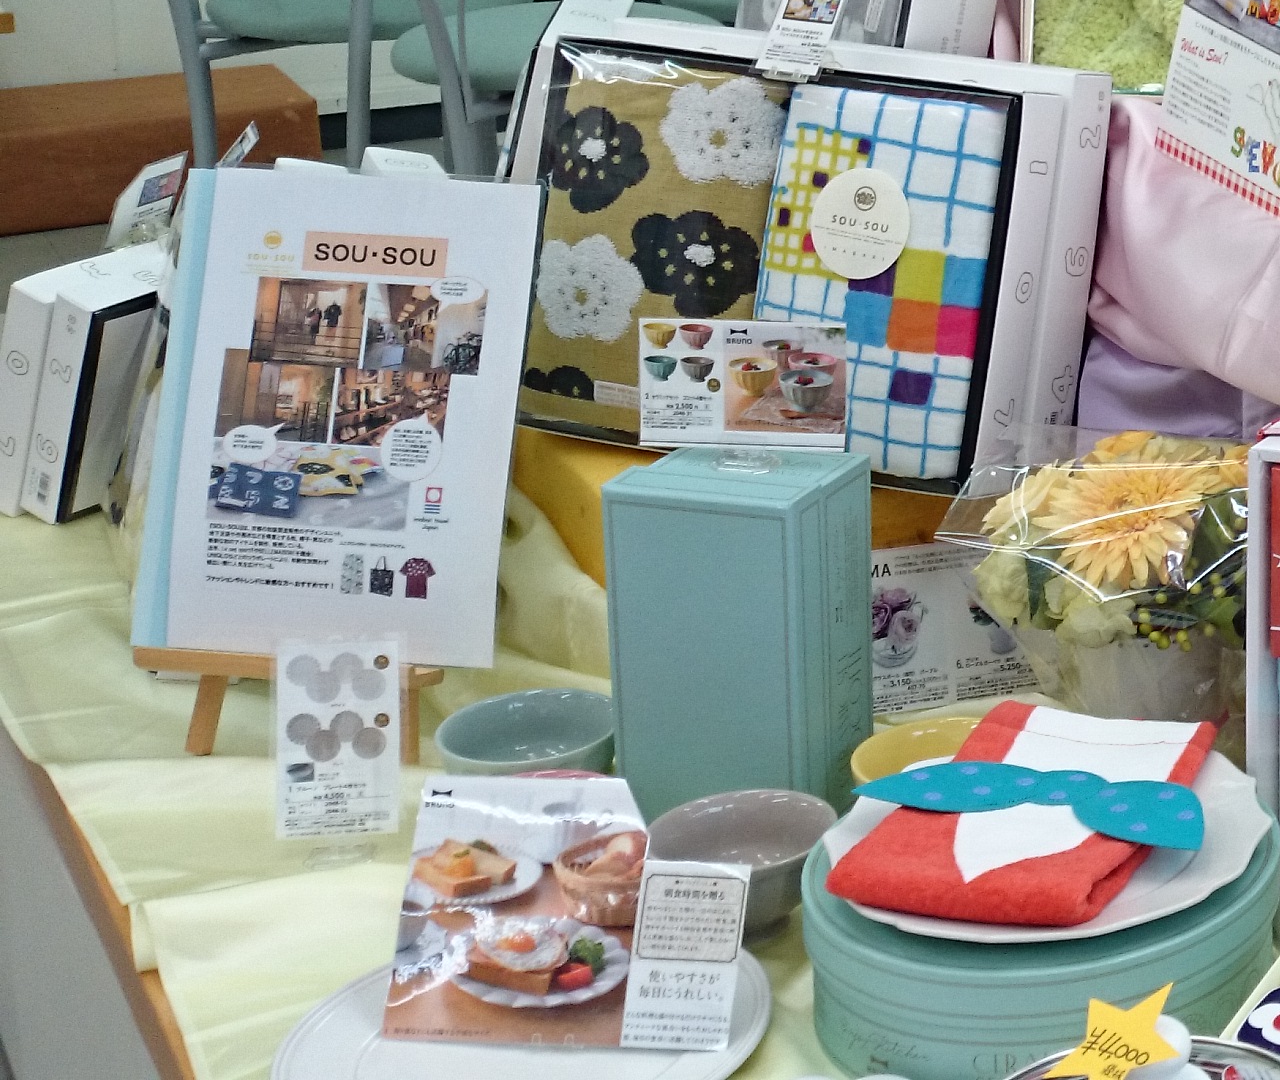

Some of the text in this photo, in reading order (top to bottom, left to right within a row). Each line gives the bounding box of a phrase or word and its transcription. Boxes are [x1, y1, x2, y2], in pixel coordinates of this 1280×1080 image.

[1180, 37, 1197, 53] What
[1199, 48, 1205, 58] is
[726, 337, 753, 345] BRUNO
[649, 970, 721, 983] 使いやすさが
[639, 986, 724, 1002] 毎日にうれしい。
